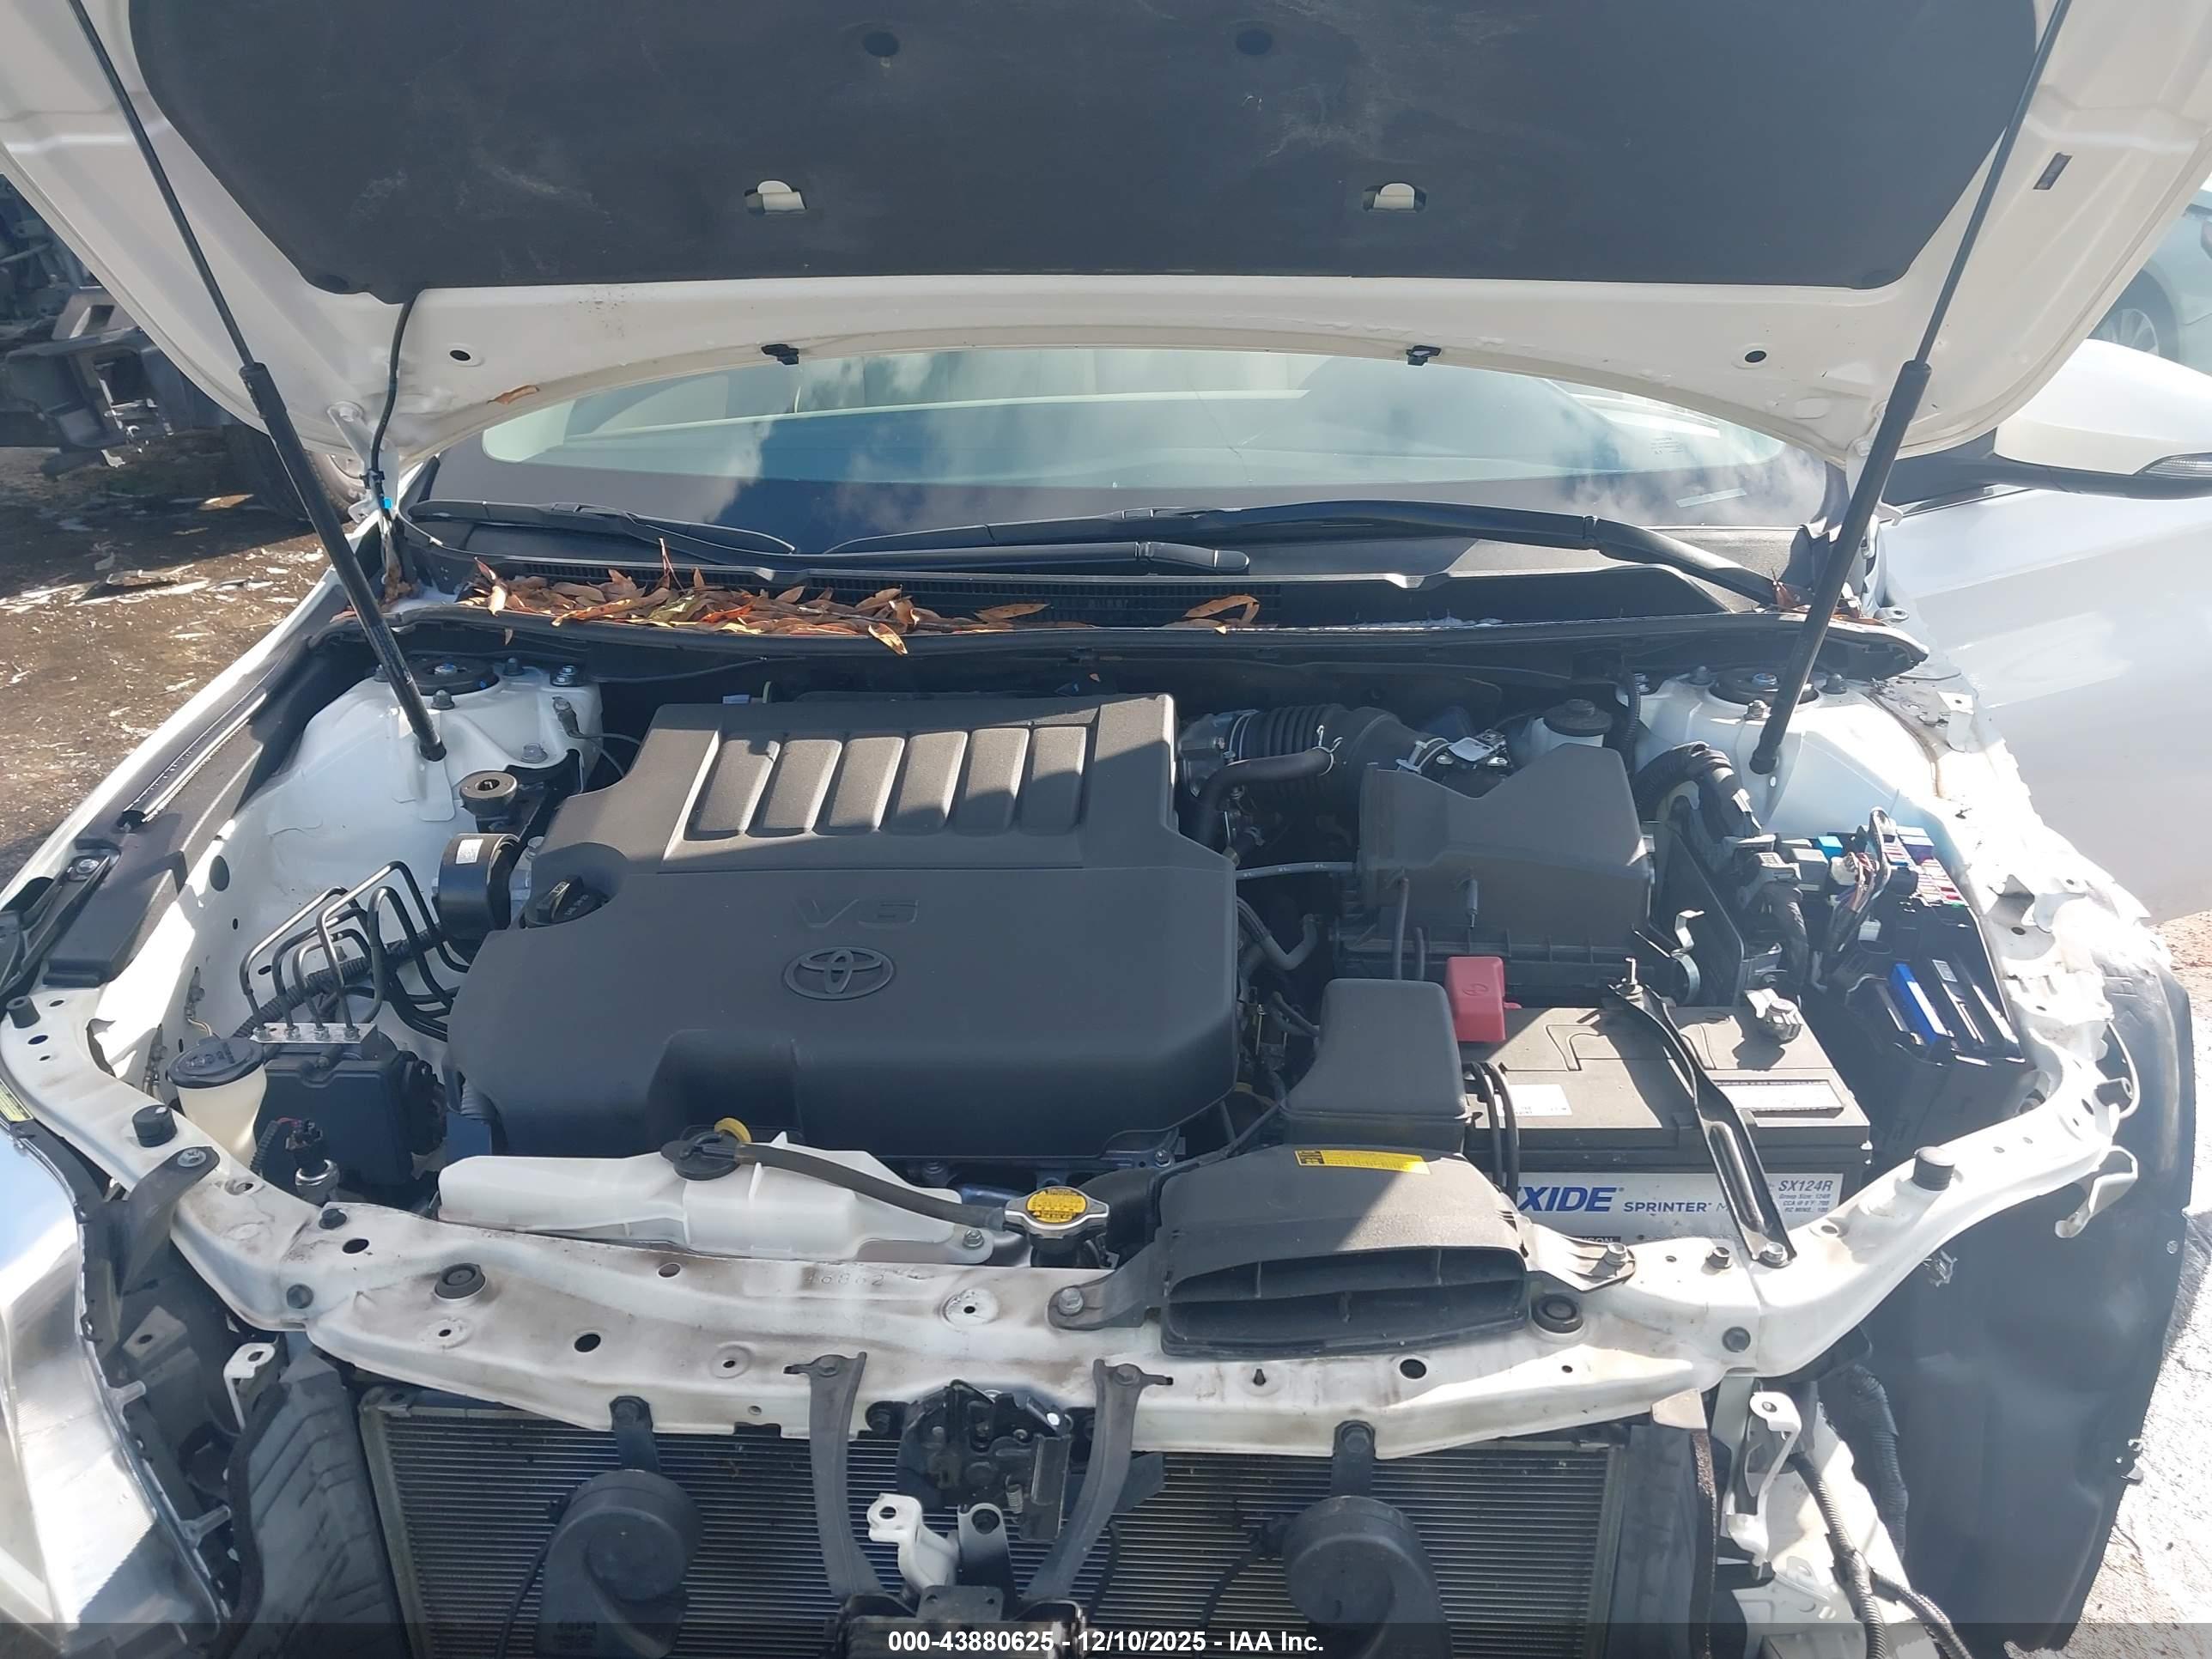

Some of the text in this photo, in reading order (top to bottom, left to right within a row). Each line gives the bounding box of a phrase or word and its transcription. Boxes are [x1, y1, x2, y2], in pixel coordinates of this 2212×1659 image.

[793, 897, 920, 928] V6
[1778, 1180, 1833, 1191] SX124R
[1517, 1187, 1617, 1212] XIDE
[1623, 1202, 1706, 1212] SPRINTER
